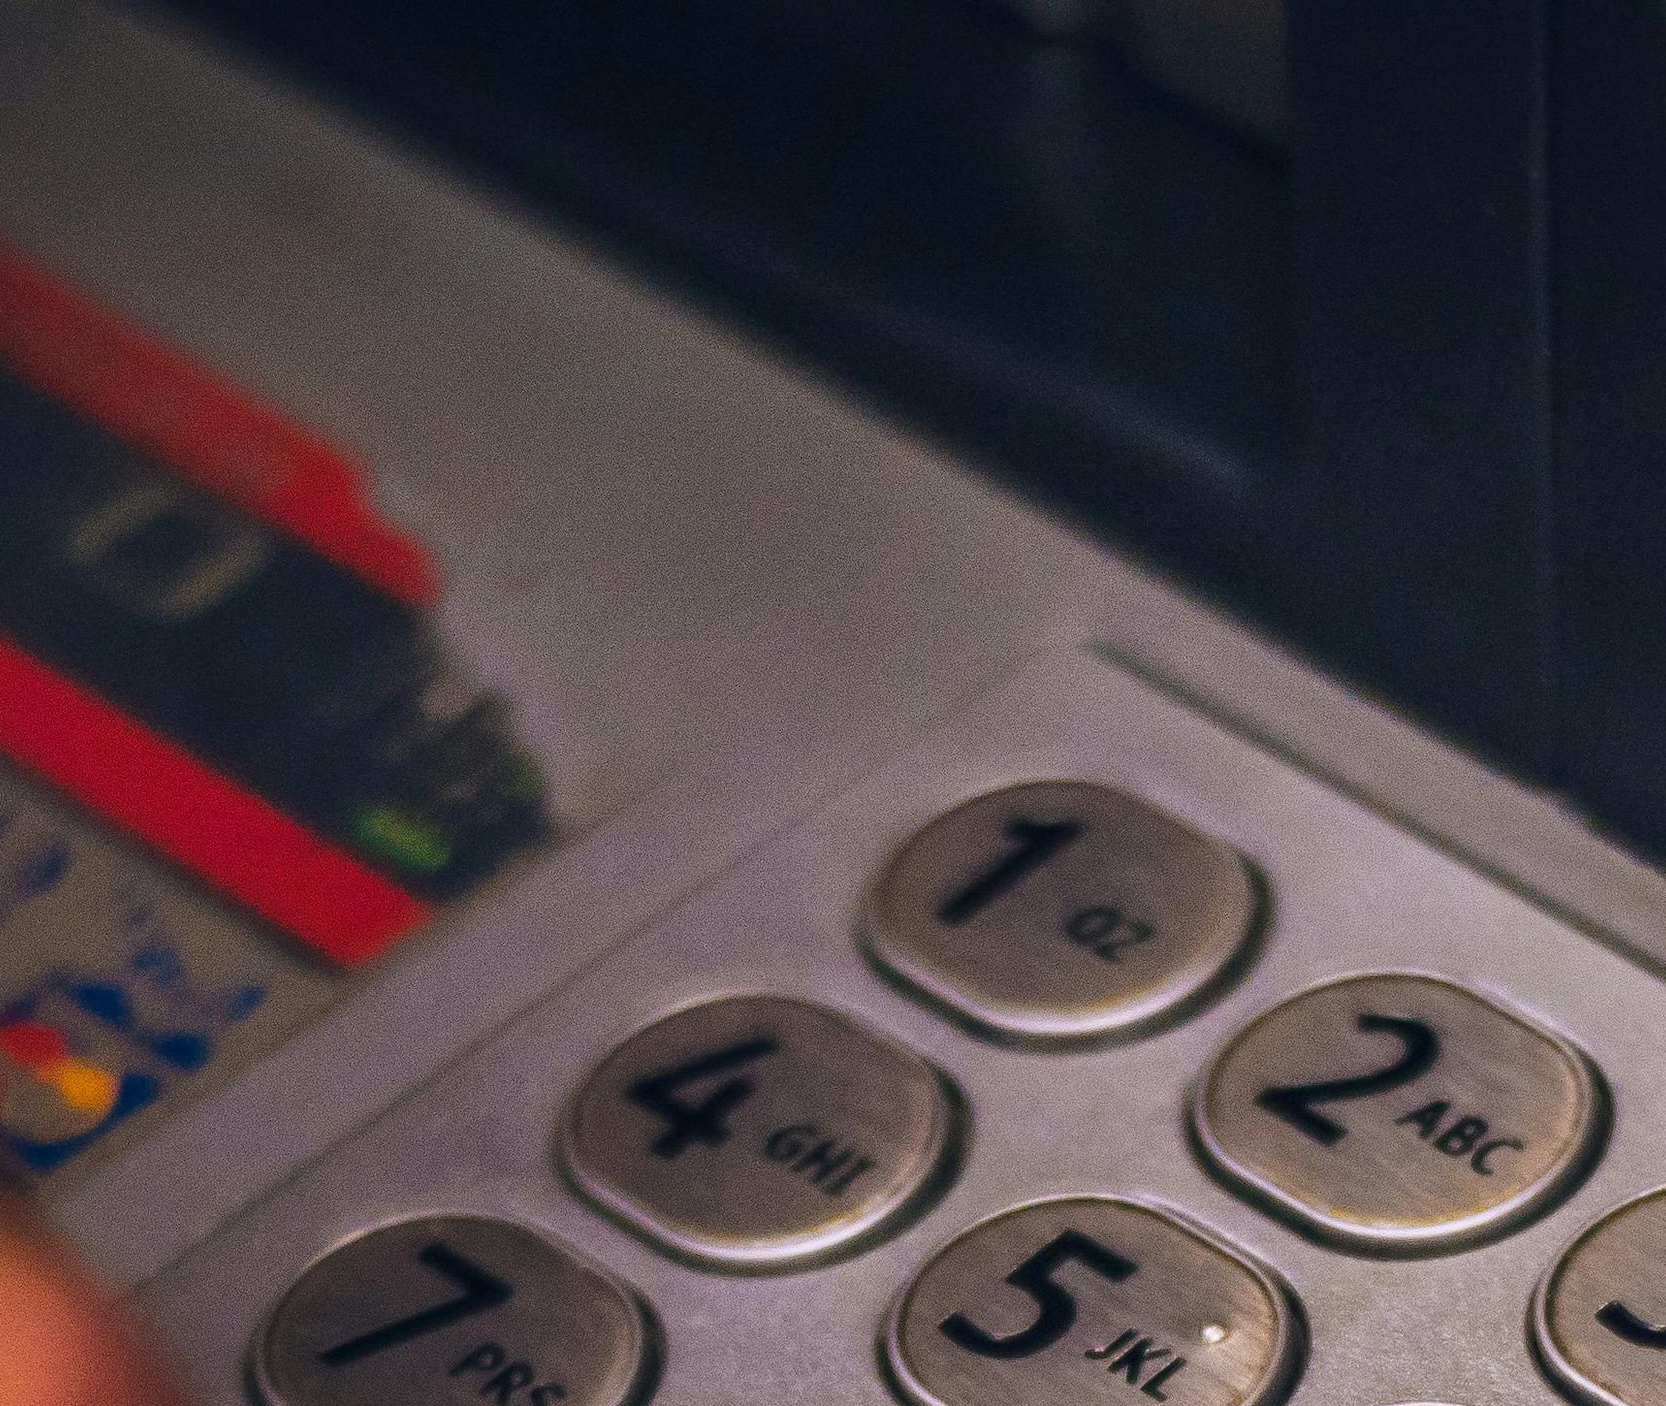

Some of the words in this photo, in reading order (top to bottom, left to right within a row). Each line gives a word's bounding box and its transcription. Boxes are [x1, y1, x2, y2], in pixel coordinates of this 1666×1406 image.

[936, 814, 1088, 926] 1
[625, 1036, 782, 1159] 4
[764, 1125, 876, 1195] GHI
[1255, 1011, 1441, 1146] 2
[1395, 1099, 1523, 1176] ABC
[319, 1240, 515, 1368] 7
[938, 1228, 1139, 1359] 5
[1085, 1328, 1187, 1402] JKL
